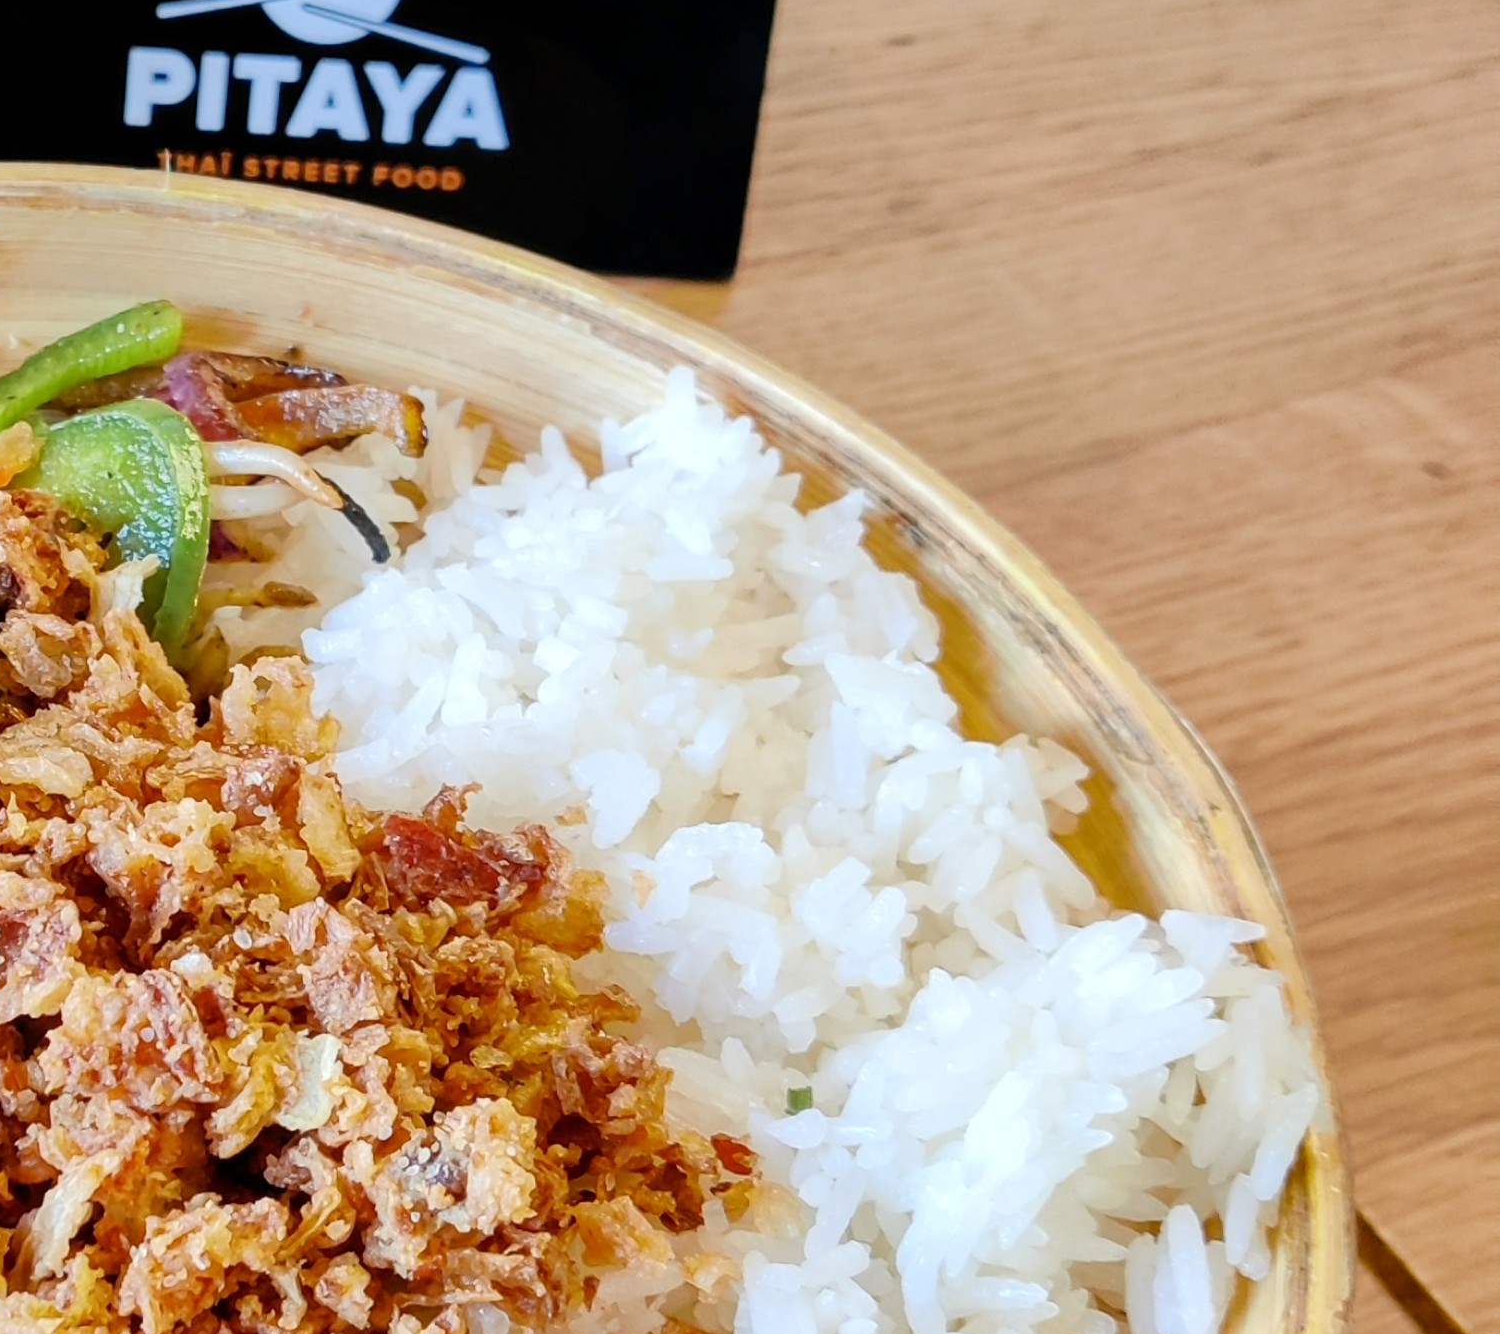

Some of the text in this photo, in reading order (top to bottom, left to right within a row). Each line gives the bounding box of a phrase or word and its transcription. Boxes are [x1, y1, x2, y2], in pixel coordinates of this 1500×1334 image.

[122, 45, 511, 151] PITAYA
[242, 154, 361, 185] STREET
[372, 163, 465, 192] FOOD
